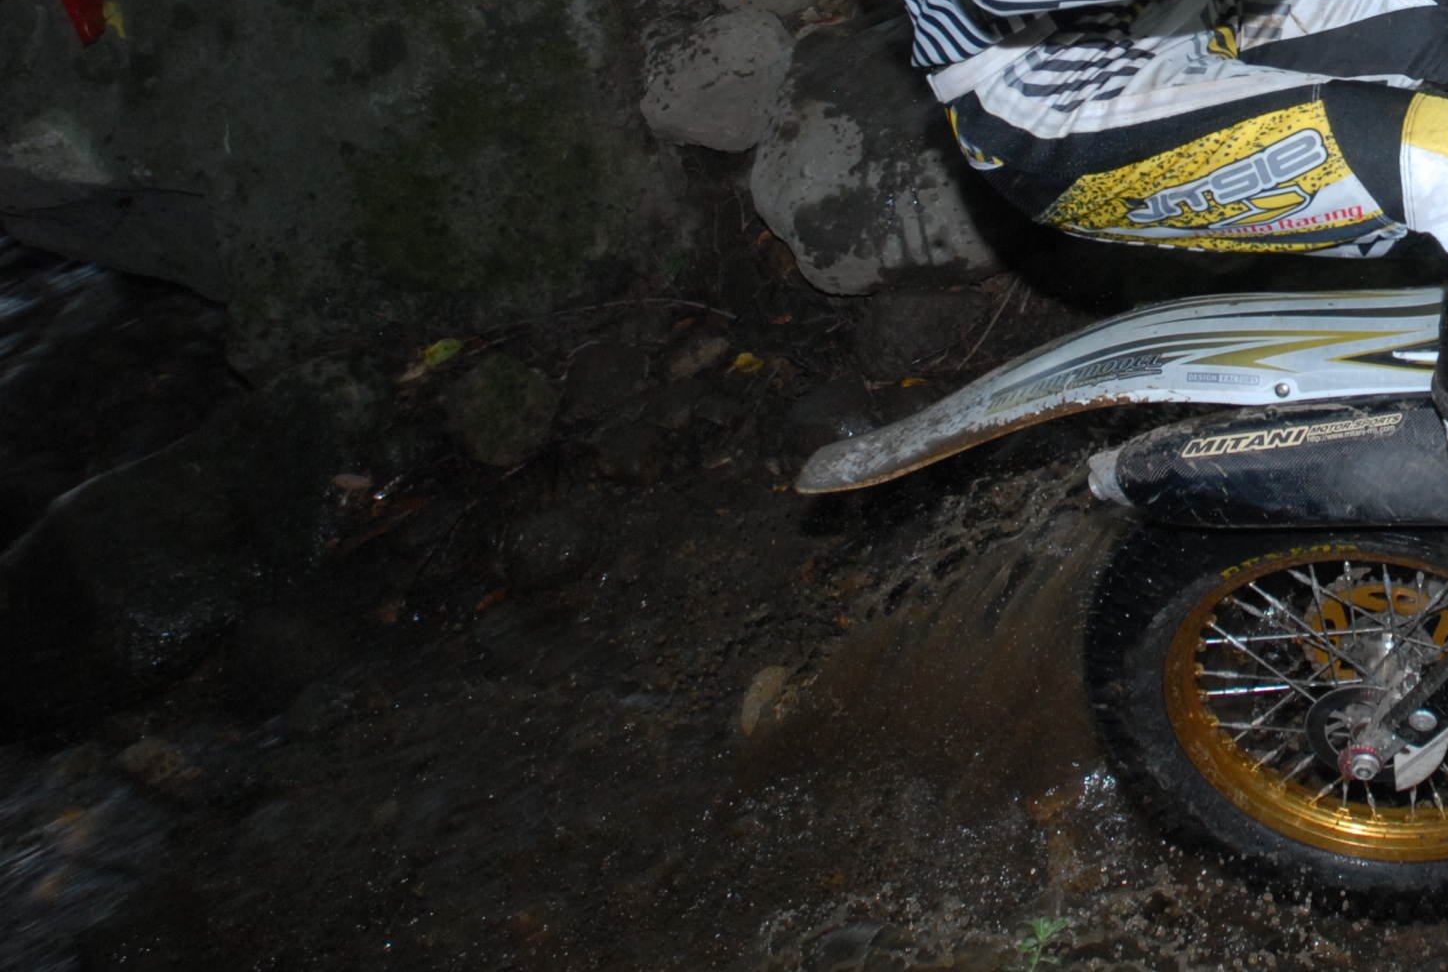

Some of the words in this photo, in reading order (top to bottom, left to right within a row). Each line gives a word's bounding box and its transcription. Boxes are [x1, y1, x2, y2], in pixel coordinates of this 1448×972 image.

[1126, 128, 1328, 224] JITSIE
[1277, 204, 1365, 232] Racing
[1183, 426, 1308, 458] MITANI
